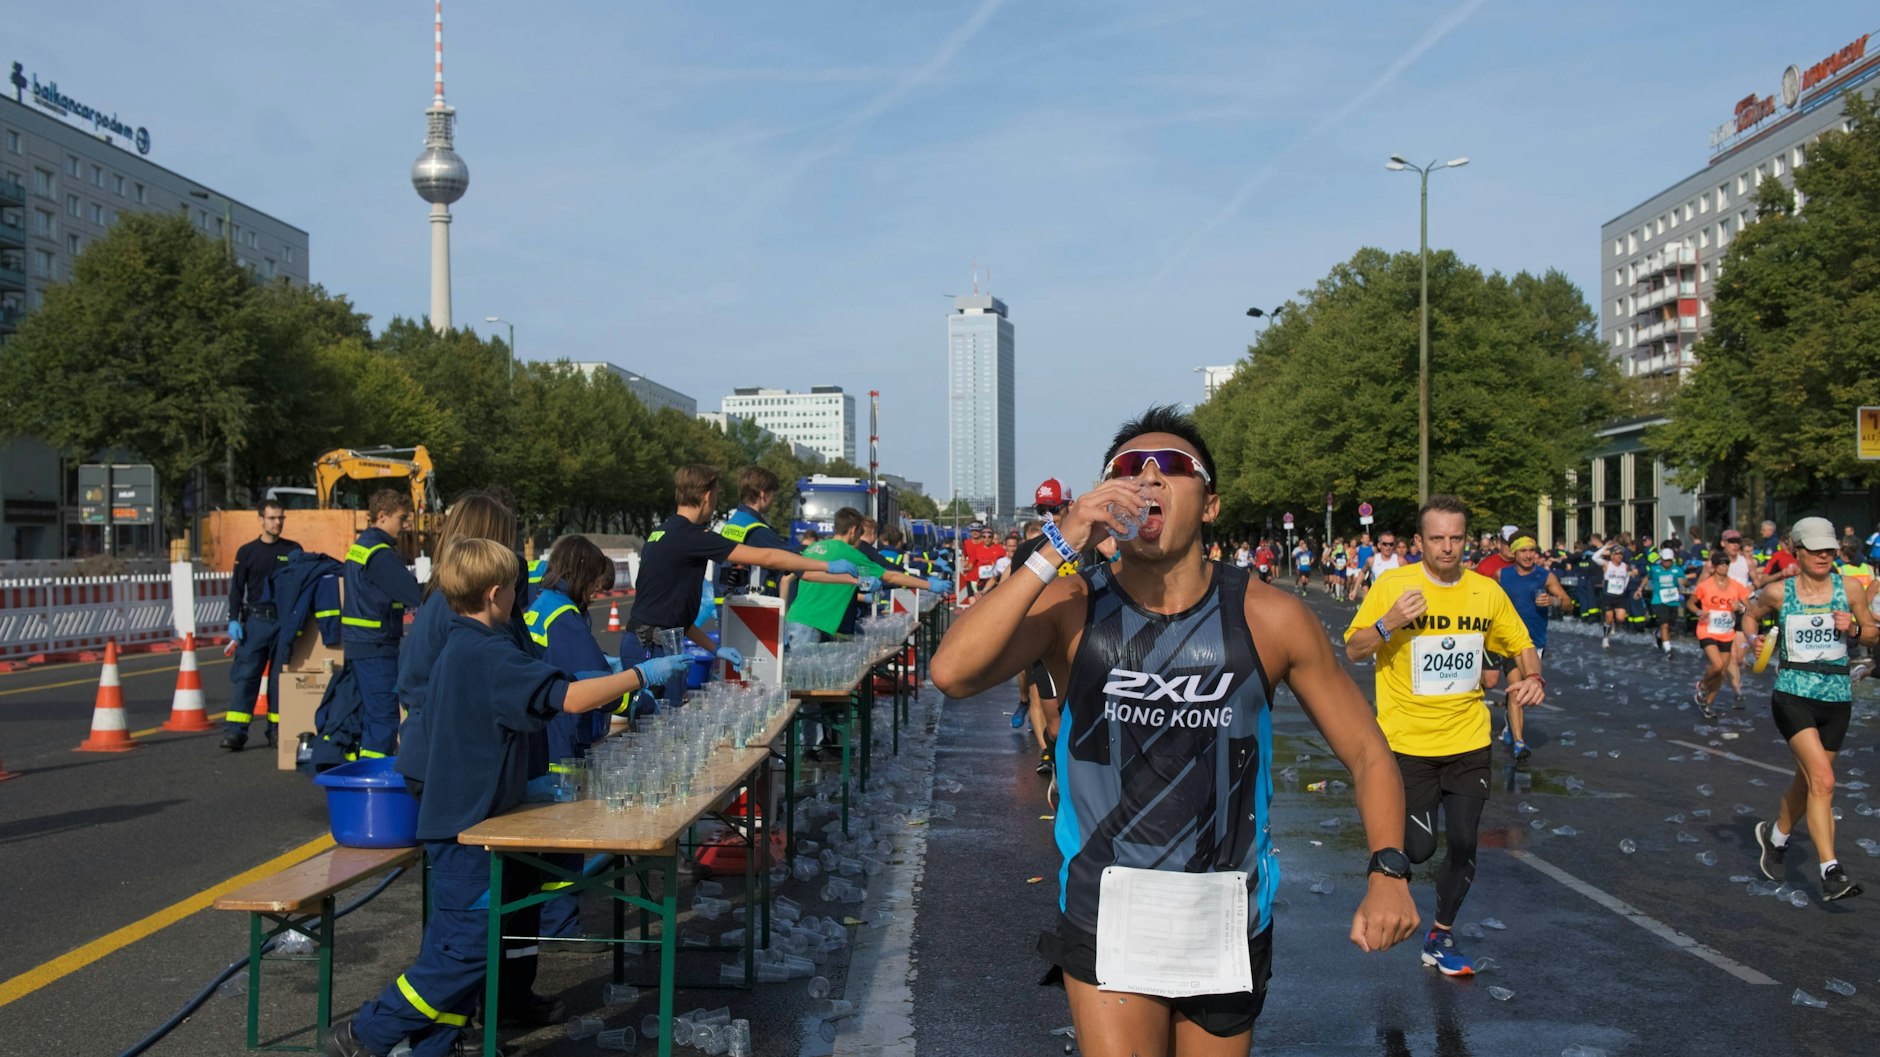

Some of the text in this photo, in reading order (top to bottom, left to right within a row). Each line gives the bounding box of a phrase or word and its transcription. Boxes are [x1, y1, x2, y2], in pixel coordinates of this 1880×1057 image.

[817, 522, 835, 533] TH
[1401, 615, 1492, 632] AVID HAL
[1795, 628, 1841, 643] 39859
[1423, 652, 1474, 672] 20468
[1102, 668, 1235, 702] 2XU
[1104, 701, 1233, 729] HONG KONG
